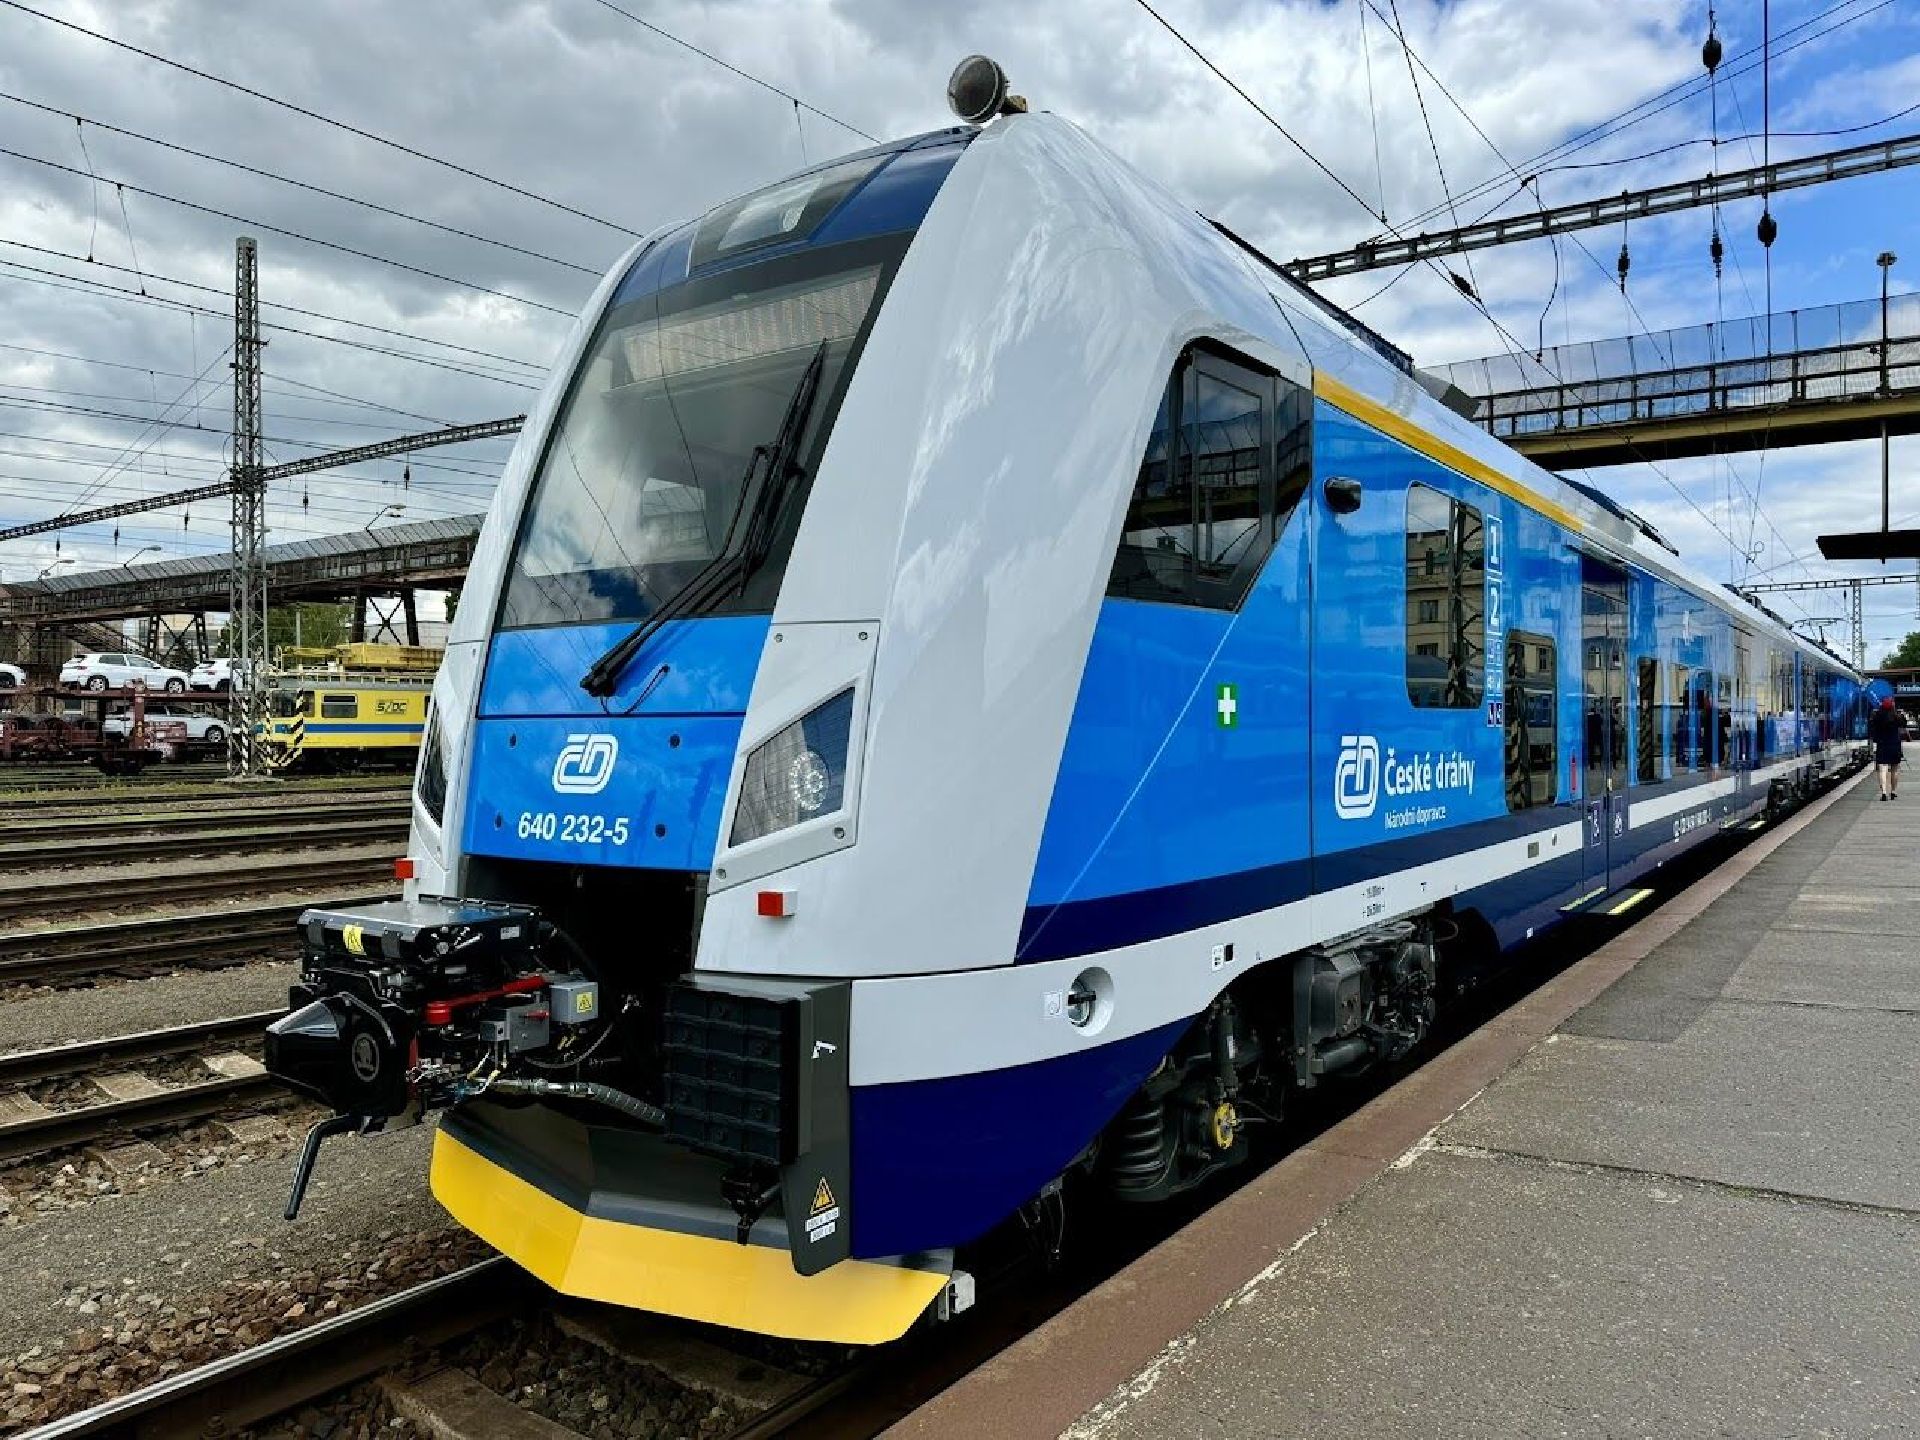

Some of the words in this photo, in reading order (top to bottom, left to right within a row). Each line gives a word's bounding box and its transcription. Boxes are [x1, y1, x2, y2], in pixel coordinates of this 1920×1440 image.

[1490, 586, 1499, 627] 2
[1384, 748, 1431, 796] České
[1435, 750, 1476, 795] dráhy
[518, 812, 557, 840] 640
[560, 814, 629, 845] 232-5
